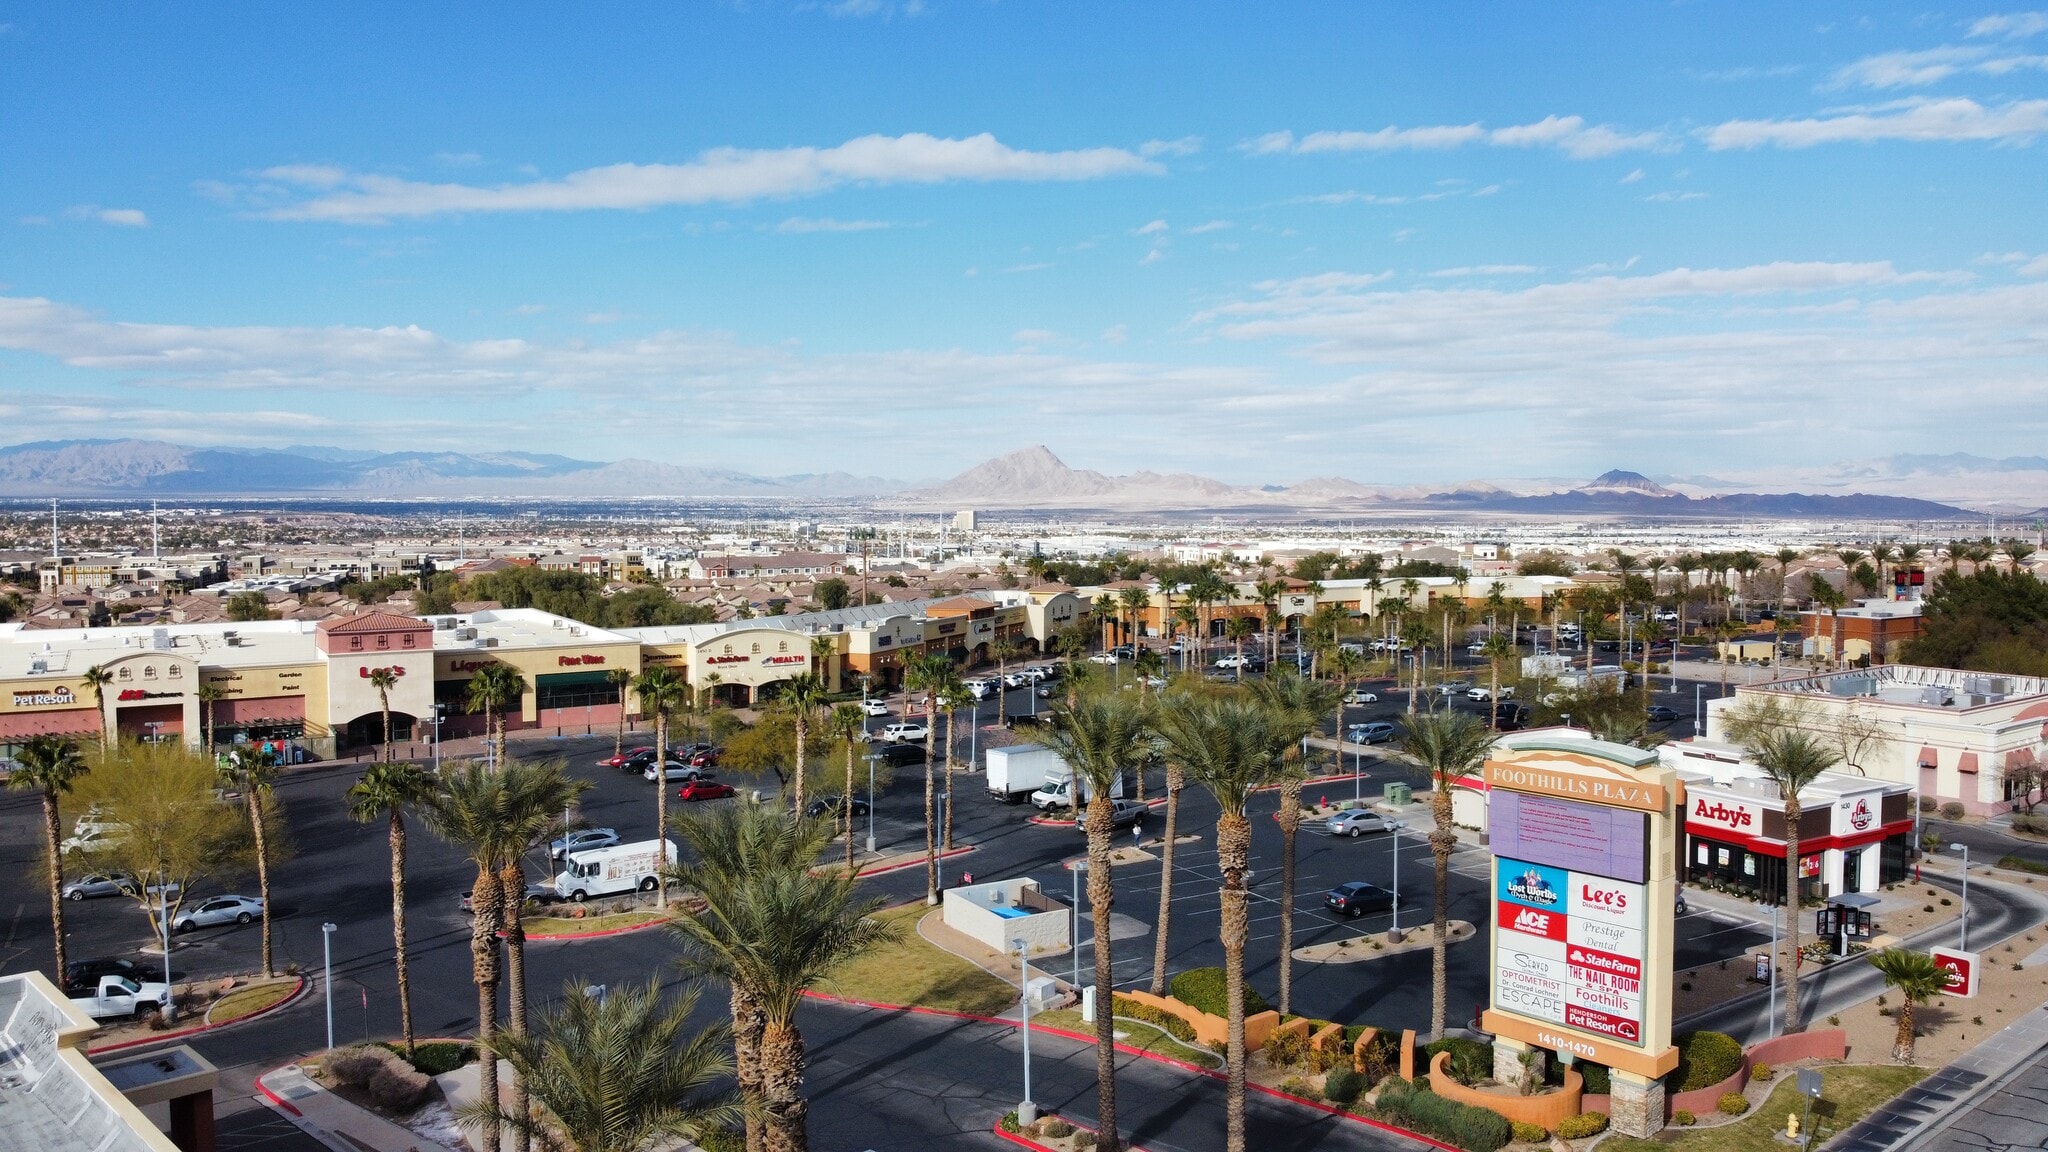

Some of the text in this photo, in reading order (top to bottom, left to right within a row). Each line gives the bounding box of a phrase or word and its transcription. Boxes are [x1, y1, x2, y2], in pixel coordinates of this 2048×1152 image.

[772, 655, 805, 665] HEALTH
[13, 692, 75, 705] Pet Resort
[117, 689, 184, 701] ACE Hardware
[1493, 767, 1653, 804] FOOTHILLS PLAZA
[1694, 798, 1752, 828] Arby's
[1508, 881, 1557, 900] Lost Worlds
[1582, 884, 1626, 908] Lee's
[1582, 901, 1626, 915] Discount Liquor
[1514, 907, 1550, 930] ACE
[1514, 922, 1548, 936] Hardware
[1583, 921, 1625, 940] Prestige
[1585, 936, 1620, 951] Dental
[1502, 970, 1561, 991] OPTOMETRIST
[1568, 965, 1639, 994] THE NAIL ROOM
[1512, 981, 1534, 992] Conrad
[1534, 987, 1560, 998] Lochner
[1502, 987, 1562, 1014] ESCAPE
[1576, 988, 1629, 1011] Foothills
[1583, 1000, 1621, 1015] Cleaners
[1569, 1007, 1608, 1022] HENDERSON
[1569, 1013, 1616, 1034] Pet Resort
[1537, 1032, 1595, 1057] 1410-1470
